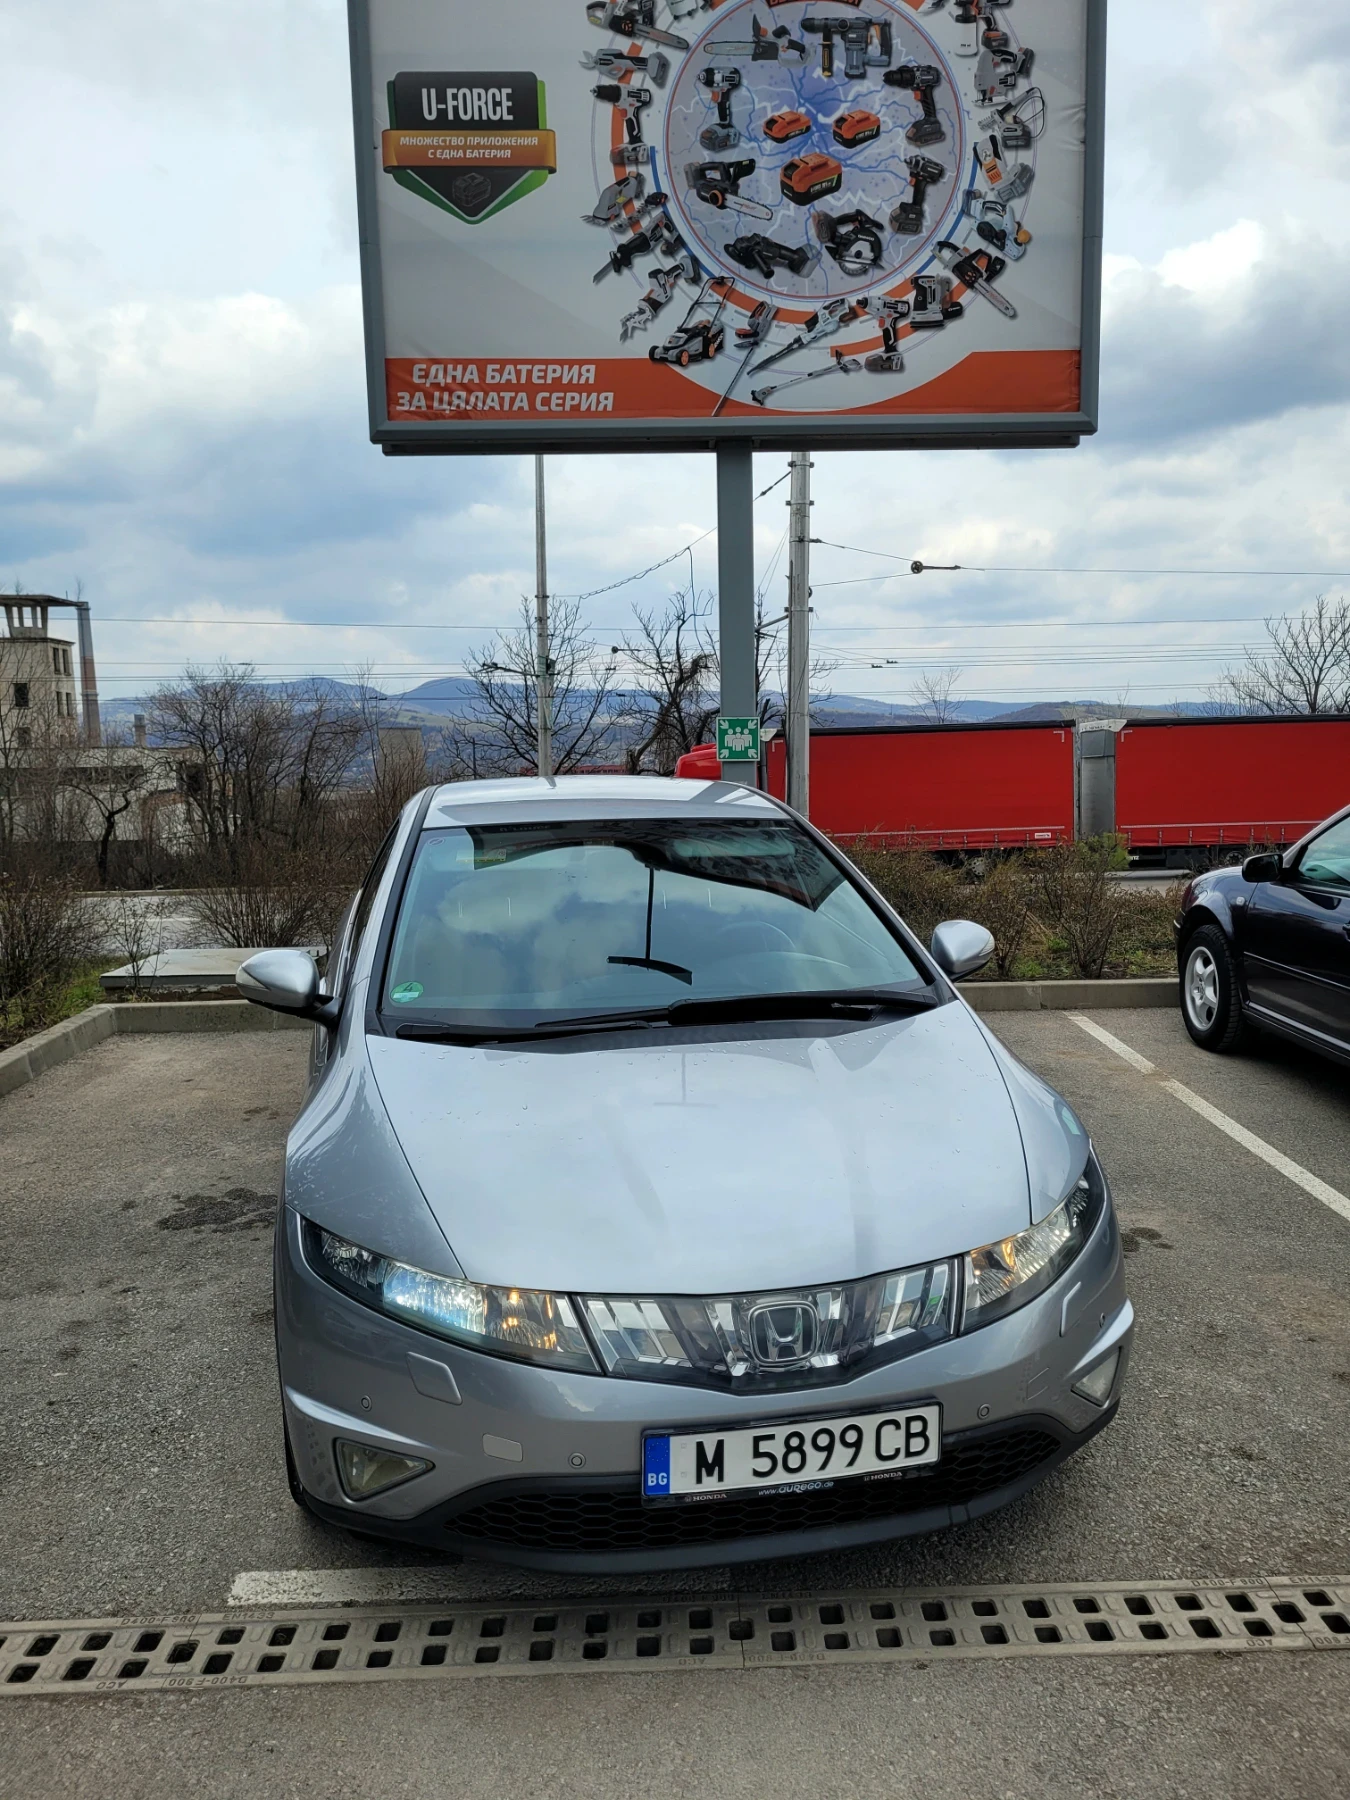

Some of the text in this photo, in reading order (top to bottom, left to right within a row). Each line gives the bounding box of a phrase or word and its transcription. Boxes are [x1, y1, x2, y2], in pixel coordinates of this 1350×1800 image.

[421, 88, 514, 120] U-FORCE
[400, 136, 538, 146] МНОЖЕСТВО ПРИЛОЖЕНИЯ
[428, 150, 511, 160] С ЕДНА БАТЕРИЯ
[412, 364, 596, 386] ЕДНА БАТЕРИЯ
[396, 392, 614, 414] ЗА ЦЯЛАТА СЕРИЯ
[695, 1414, 930, 1484] M 5899 CB
[648, 1472, 668, 1486] BG
[870, 1471, 902, 1480] HONDA
[692, 1493, 727, 1502] HONDA
[96, 1680, 128, 1690] ACO
